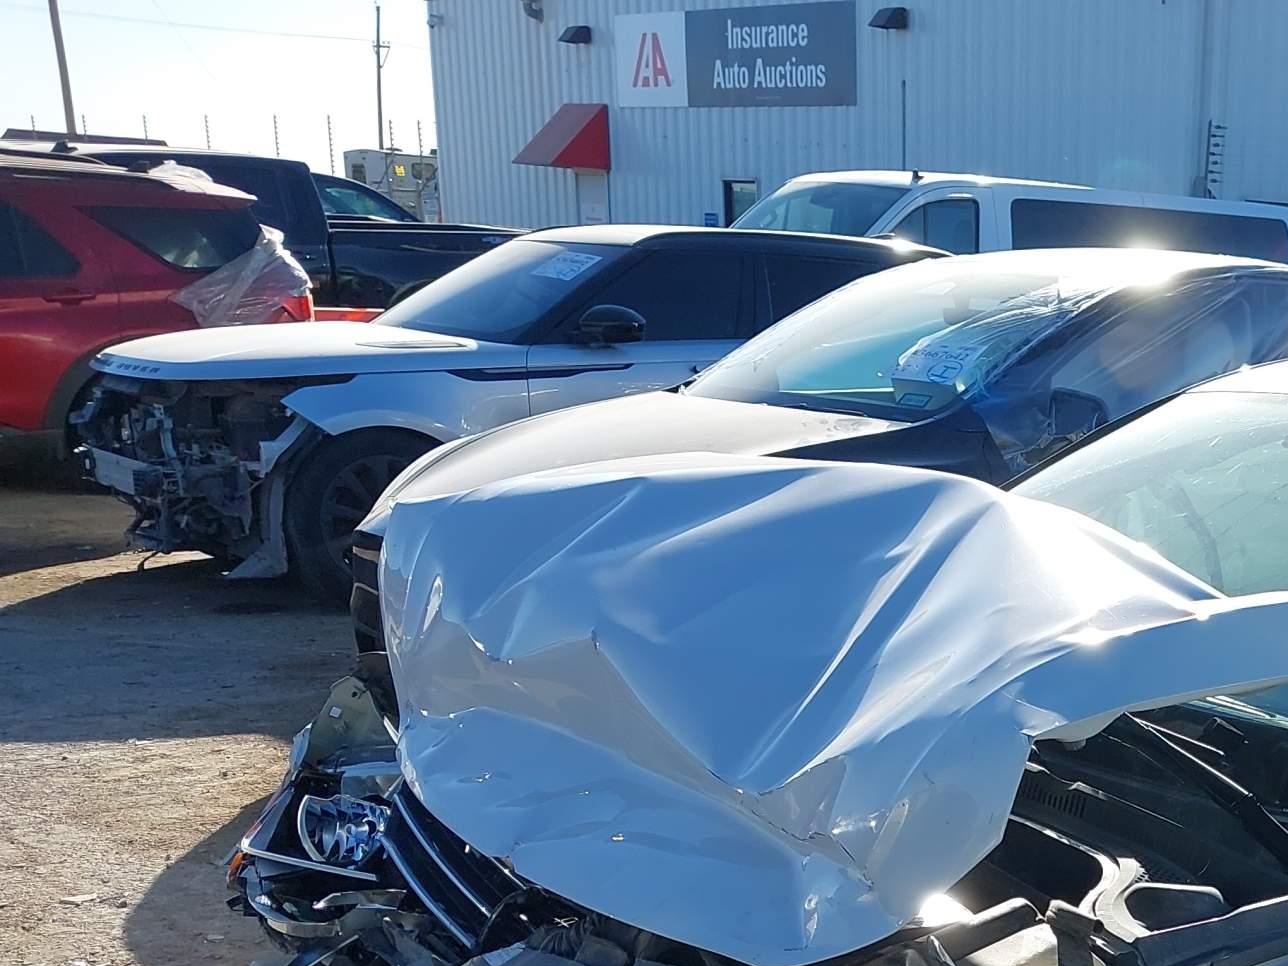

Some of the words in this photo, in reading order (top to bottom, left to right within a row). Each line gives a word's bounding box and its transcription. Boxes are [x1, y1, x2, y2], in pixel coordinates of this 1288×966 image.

[727, 19, 808, 49] Insurance
[713, 59, 748, 89] Auto
[754, 57, 826, 88] Auctions
